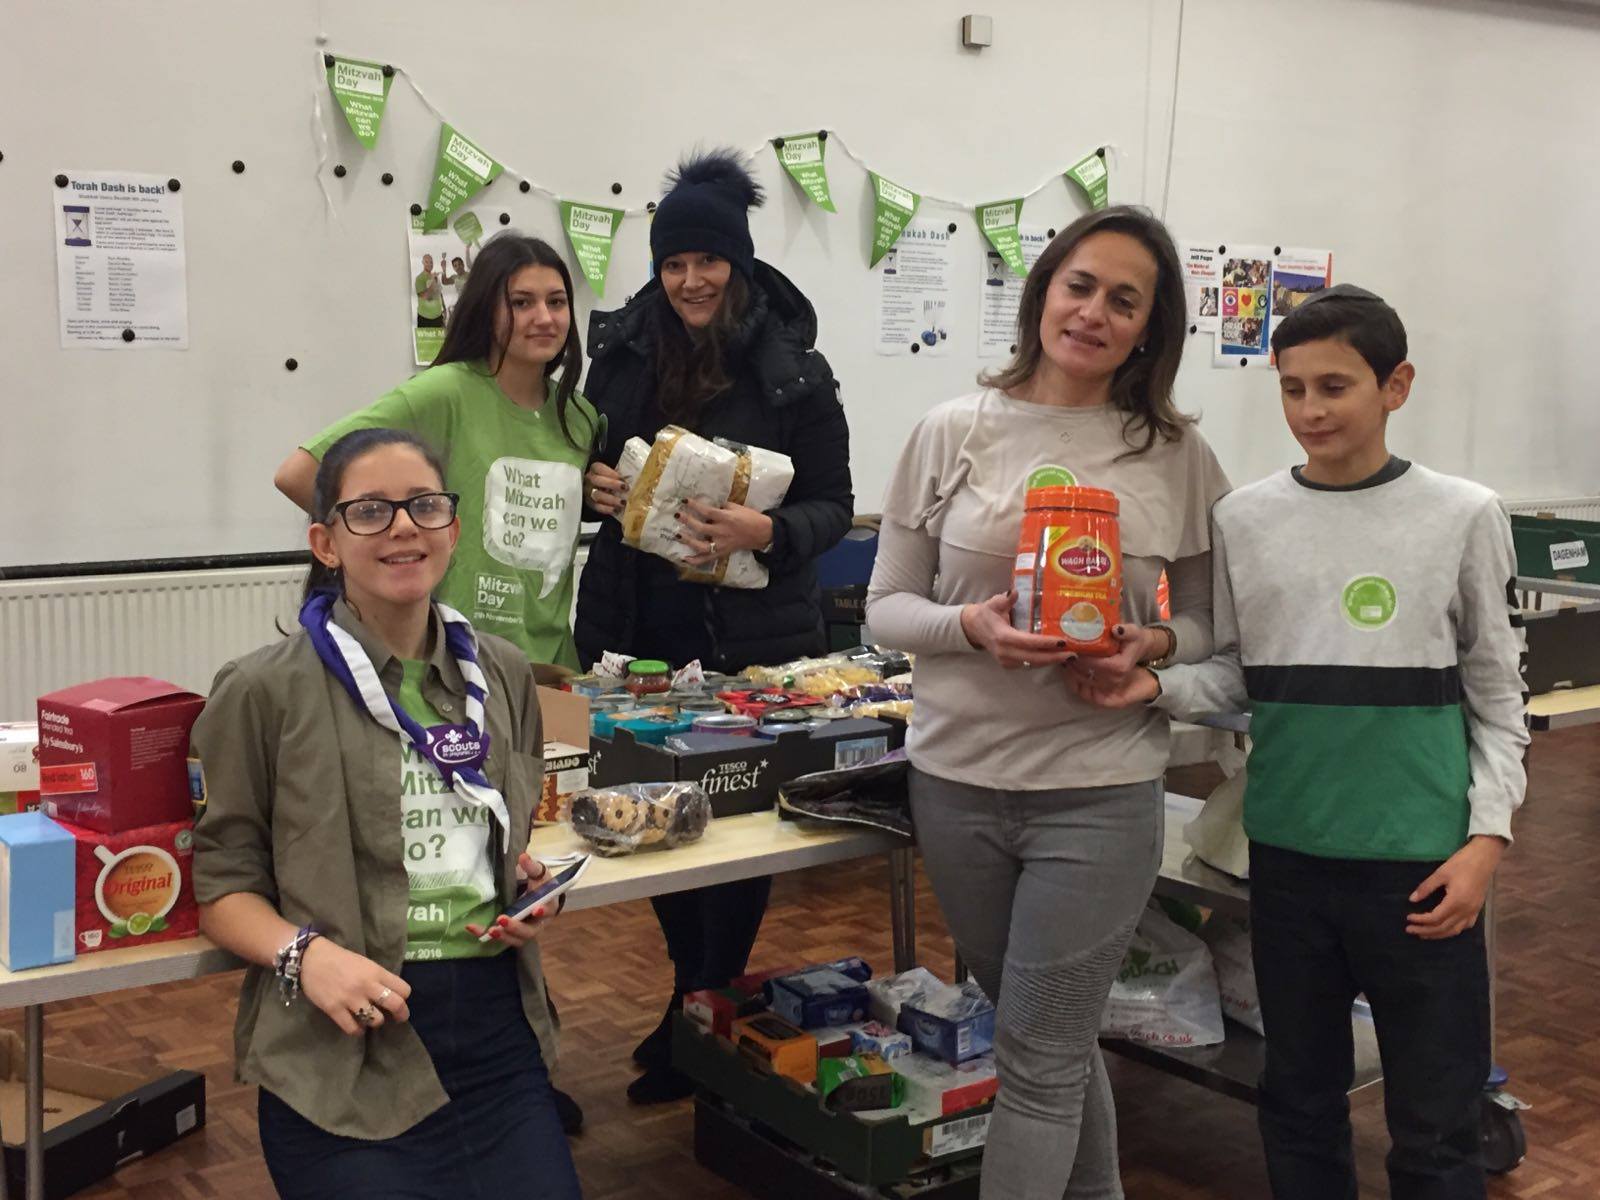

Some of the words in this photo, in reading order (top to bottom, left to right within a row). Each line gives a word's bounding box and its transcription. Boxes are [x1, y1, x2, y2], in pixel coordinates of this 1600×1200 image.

[337, 65, 381, 81] Mitzvah
[337, 75, 359, 88] Day
[346, 106, 379, 119] Mitzvah
[350, 100, 373, 111] What
[451, 144, 469, 162] Day
[453, 137, 490, 168] Mitzvah
[784, 141, 817, 152] Mitzvah
[785, 152, 801, 161] Day
[438, 173, 468, 199] Mitzvah
[449, 170, 468, 188] What
[71, 181, 98, 192] Torah
[101, 182, 125, 193] Dash
[128, 184, 136, 193] is
[139, 185, 165, 195] back!
[433, 201, 451, 215] do?
[984, 206, 1015, 217] Mitzvah
[572, 209, 610, 224] Mitzvah
[985, 217, 1000, 226] Day
[572, 219, 590, 231] Day
[504, 464, 541, 489] What
[505, 486, 566, 511] Mitzvah
[503, 511, 526, 528] can
[530, 516, 558, 530] we
[503, 530, 526, 549] do?
[1061, 557, 1085, 566] WAGH
[1552, 546, 1587, 561] DAGENHAM
[477, 590, 506, 609] Day
[41, 709, 70, 725] Fairtrade
[42, 735, 50, 748] by
[50, 737, 83, 754] Sainsbury's
[80, 767, 95, 780] 160
[720, 762, 747, 770] TESCO
[700, 766, 761, 795] finest
[401, 808, 442, 830] an
[401, 833, 446, 862] o?
[106, 871, 172, 897] Original
